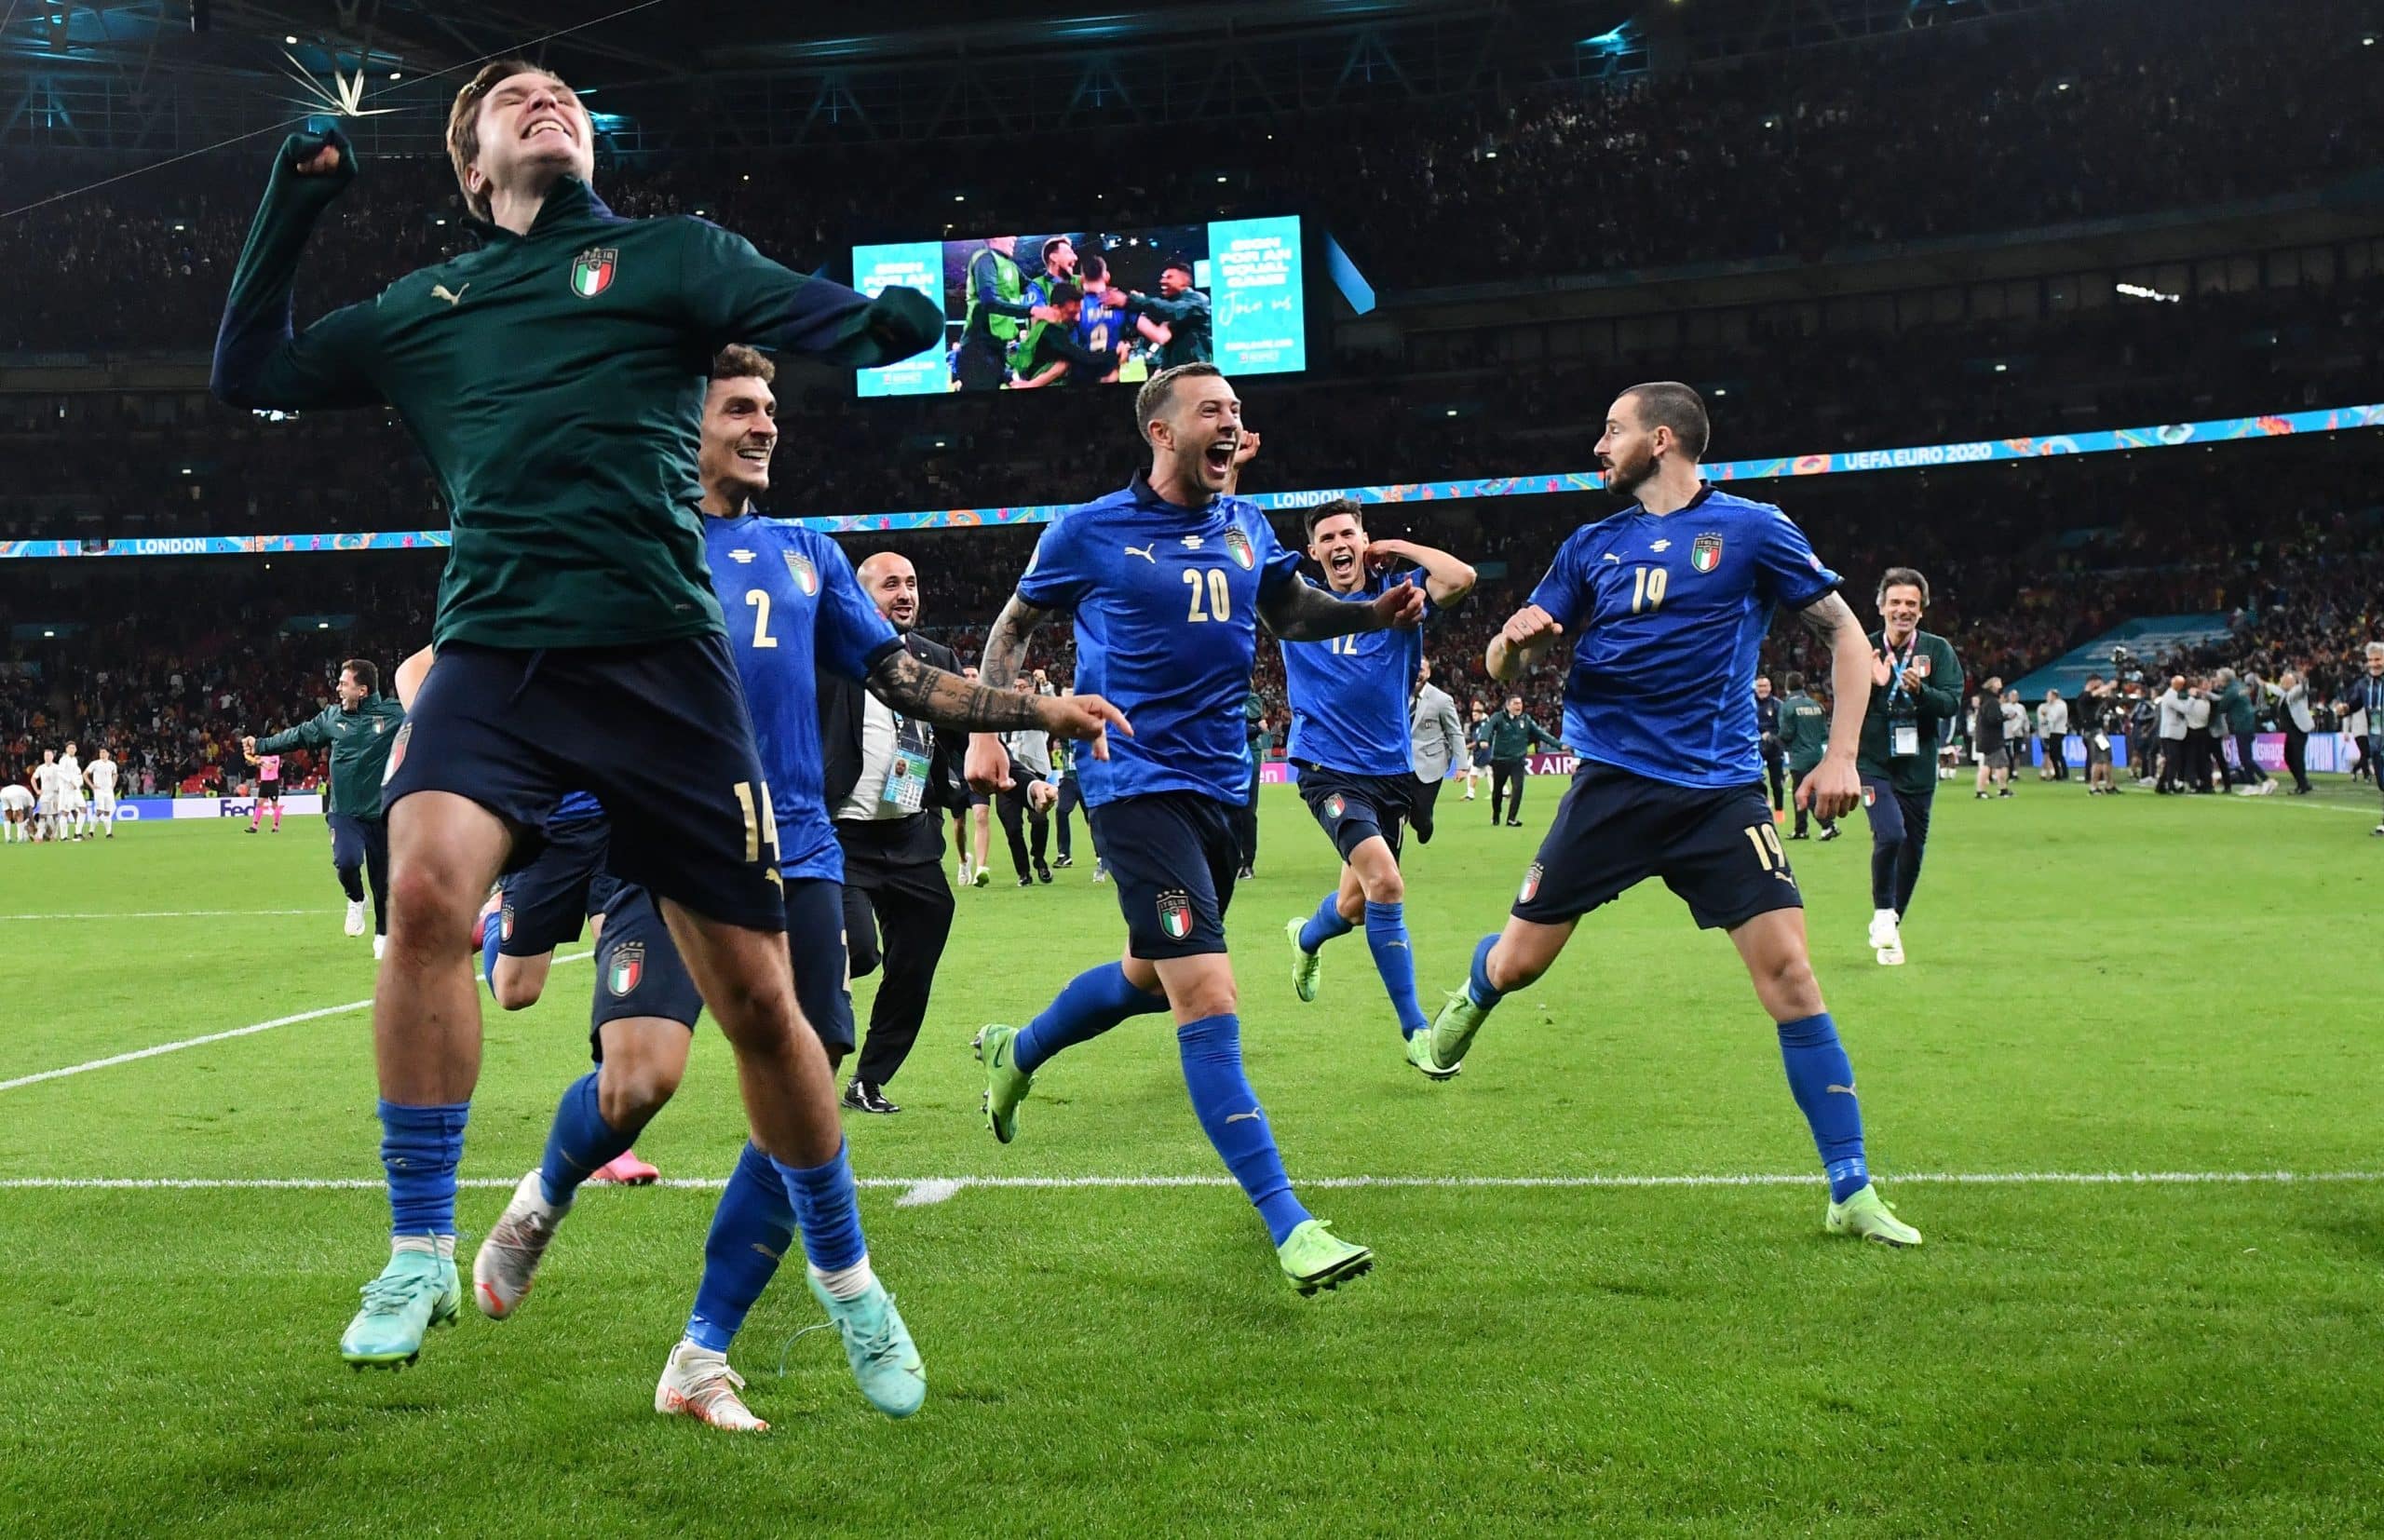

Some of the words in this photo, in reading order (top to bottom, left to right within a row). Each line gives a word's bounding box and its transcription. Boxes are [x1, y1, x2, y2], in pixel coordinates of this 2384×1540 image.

[1845, 452, 1892, 468] UEFA
[1893, 447, 1944, 466] EURO
[1945, 442, 1992, 462] 2020
[1273, 490, 1345, 507] LONDON
[136, 538, 207, 554] LONDON
[1183, 568, 1230, 623] 20
[1632, 567, 1668, 615] 19
[745, 588, 778, 648] 2
[734, 781, 780, 862] 14
[1744, 823, 1785, 871] 19
